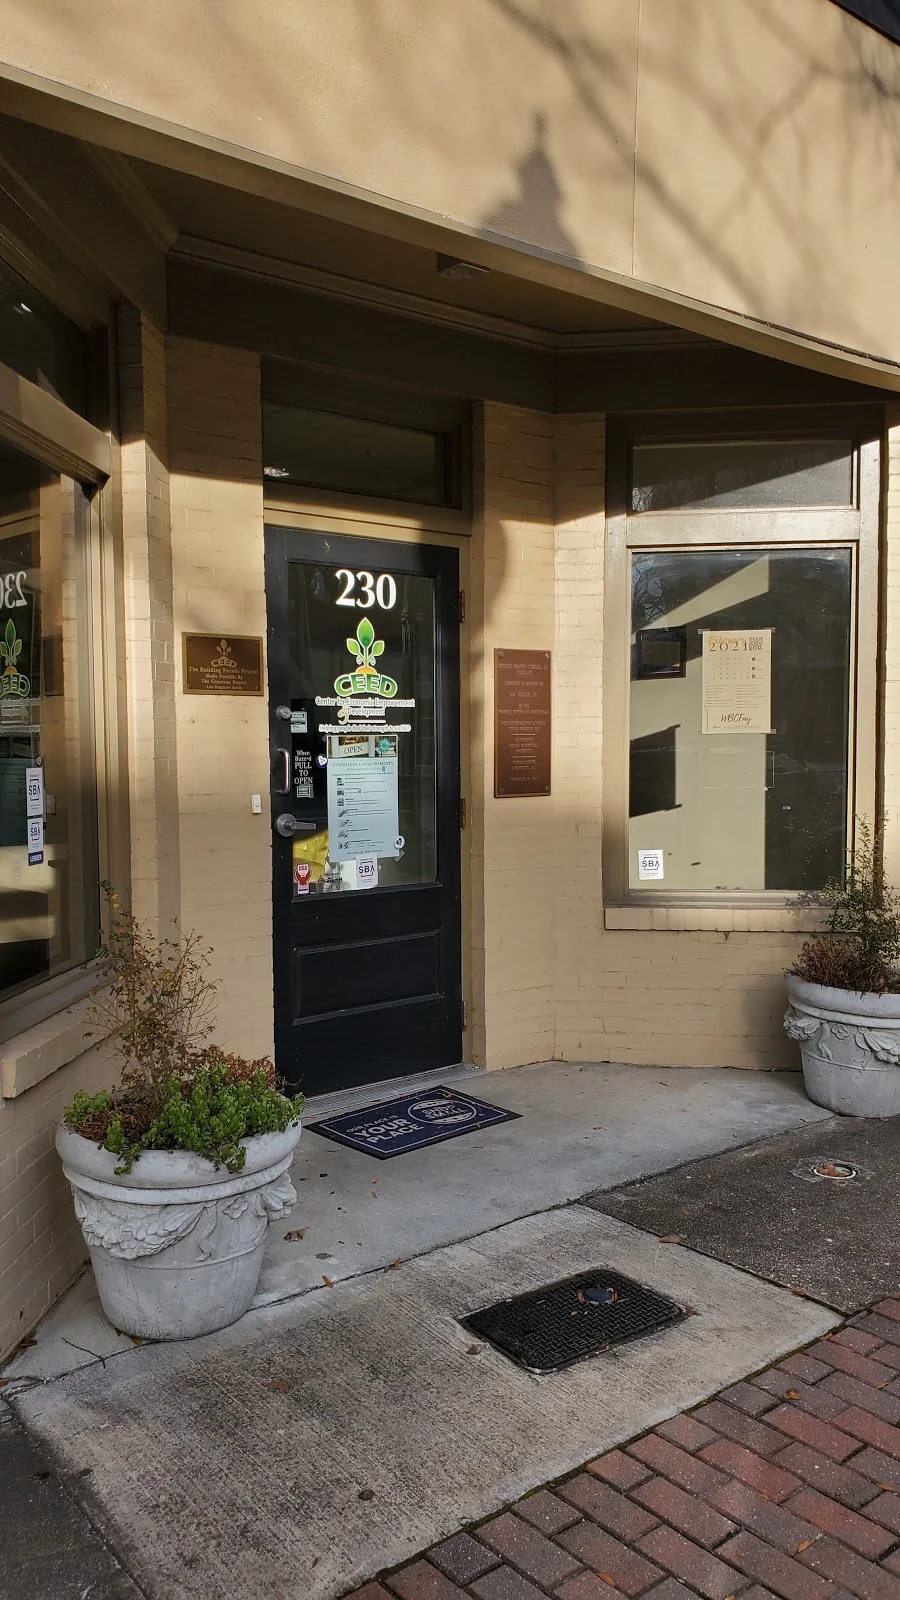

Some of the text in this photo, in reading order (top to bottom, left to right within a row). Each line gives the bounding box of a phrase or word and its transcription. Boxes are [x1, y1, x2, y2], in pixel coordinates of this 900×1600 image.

[335, 568, 397, 610] 230
[708, 641, 748, 652] 2021
[210, 658, 238, 668] CEED
[334, 672, 398, 698] CEED
[315, 696, 416, 708] Center for Economic Empowerment
[348, 707, 386, 717] Development
[344, 745, 363, 755] OPEN
[294, 777, 313, 785] OPEN
[28, 784, 40, 796] SBA
[358, 865, 375, 874] SBA
[346, 1125, 364, 1133] OUR
[362, 1117, 391, 1129] PLACE
[353, 1118, 412, 1139] YOUR
[366, 1123, 425, 1144] PLACE
